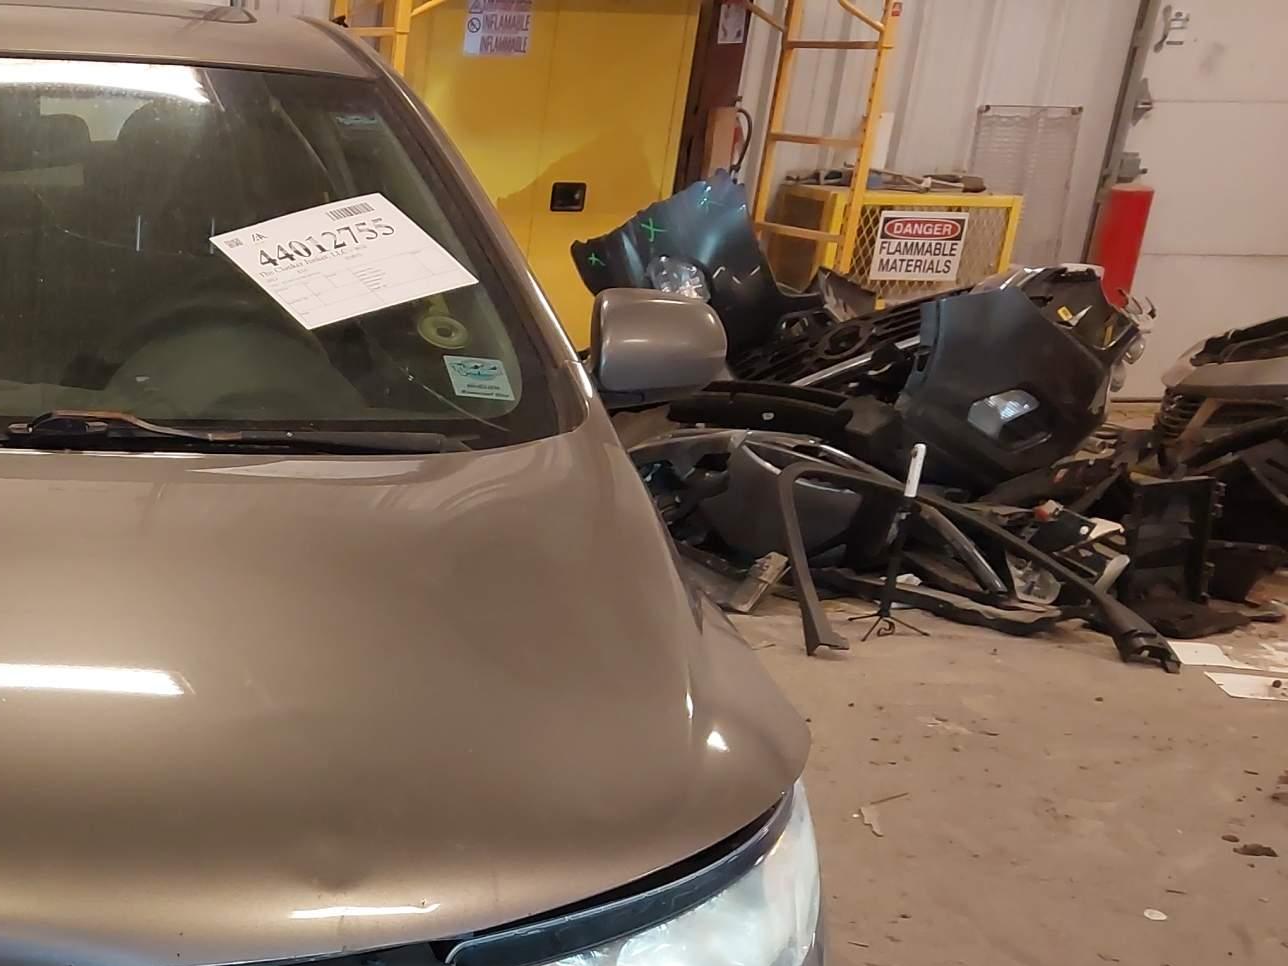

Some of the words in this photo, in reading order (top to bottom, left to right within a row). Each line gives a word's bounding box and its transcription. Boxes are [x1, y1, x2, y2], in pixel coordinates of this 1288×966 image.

[893, 223, 952, 236] DANGER
[259, 218, 395, 267] 44012755
[879, 241, 958, 257] FLAMMABLE
[877, 258, 952, 274] MATERIALS
